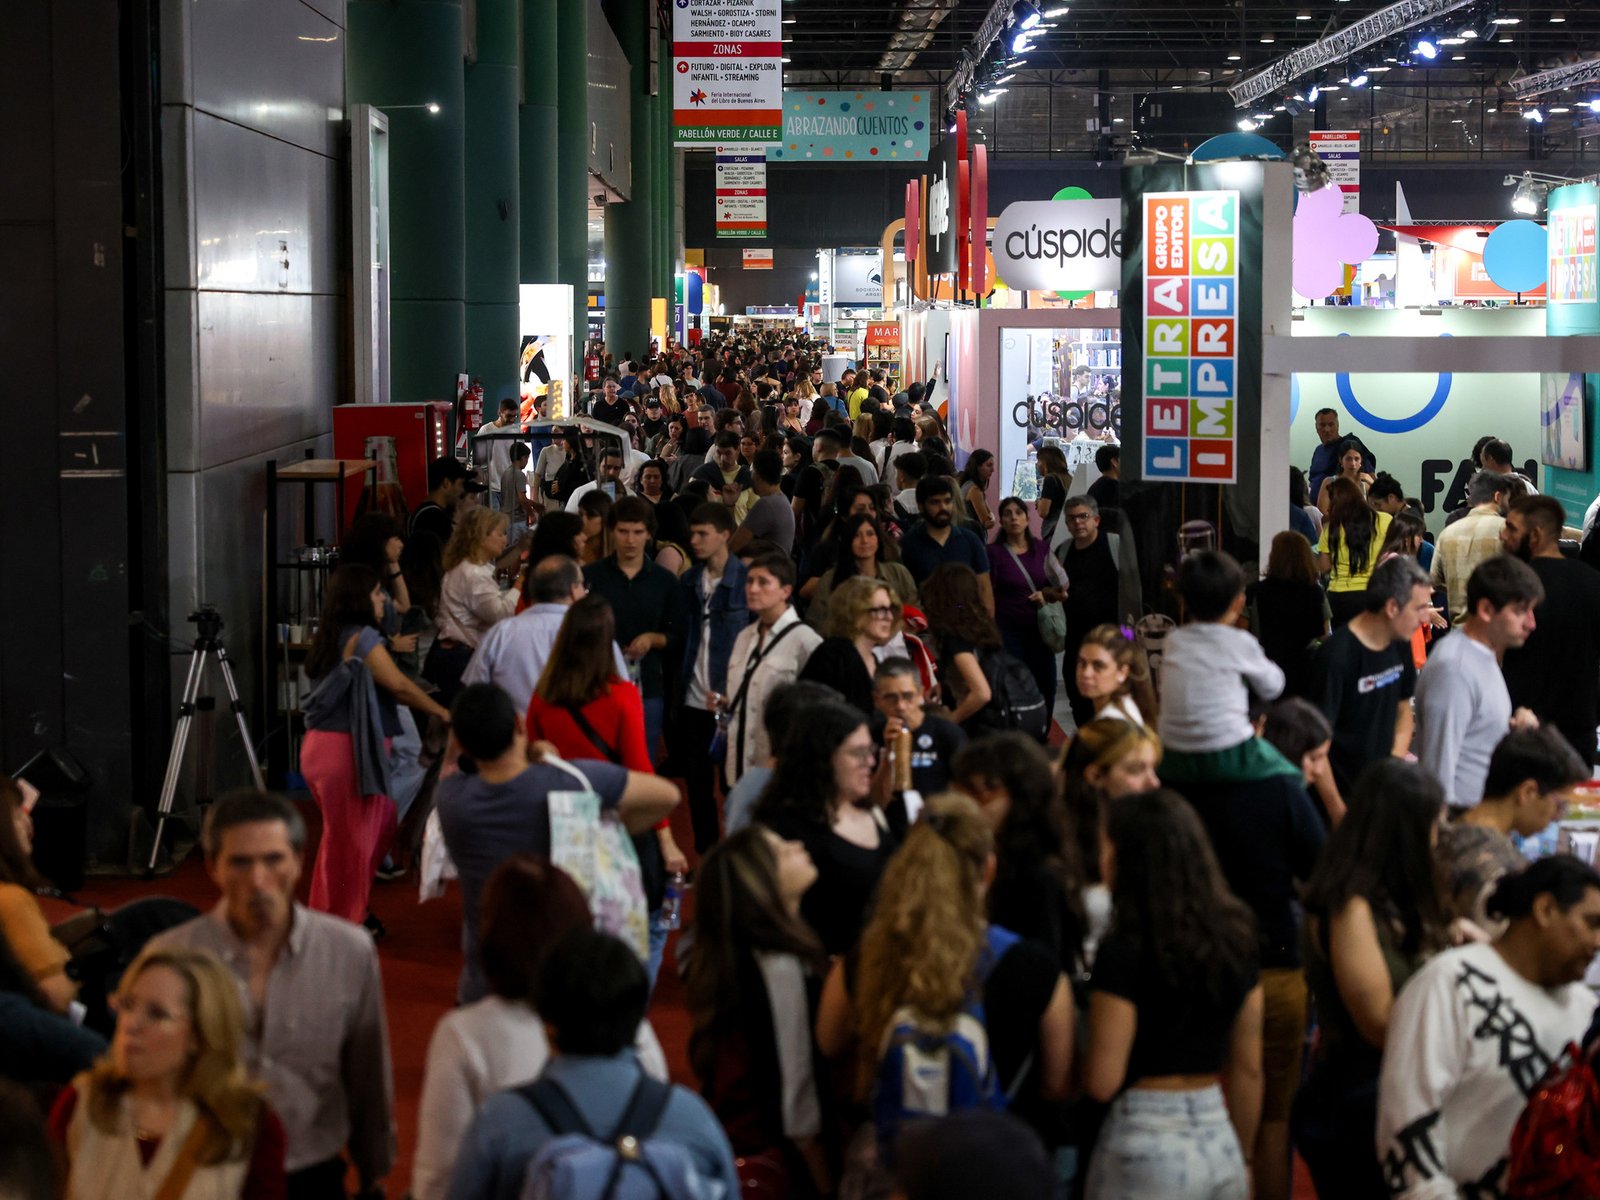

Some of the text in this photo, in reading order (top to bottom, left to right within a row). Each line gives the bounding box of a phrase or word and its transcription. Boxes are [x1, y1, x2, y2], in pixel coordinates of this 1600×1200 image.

[690, 9, 777, 17] WALSH GOROSTIZA STORNI
[690, 18, 756, 27] HERNÁNDEZ OCAMPO
[690, 30, 771, 38] SARMIENTO BIOY CASARES
[713, 44, 742, 54] ZONAS
[690, 63, 777, 71] FUTURO DIGITAL EXPLORA
[691, 73, 760, 81] INFANTIL STREAMING
[678, 127, 715, 139] PABELLÓN
[717, 129, 740, 139] VERDE
[749, 129, 771, 139] CALLE
[773, 129, 778, 139] E
[1155, 205, 1168, 270] GRUPO
[1170, 204, 1184, 269] EDITOR
[1005, 218, 1121, 268] cúspide
[1197, 193, 1229, 466] IMPRESA
[1153, 277, 1184, 469] LETRA
[1013, 394, 1121, 438] cúspide
